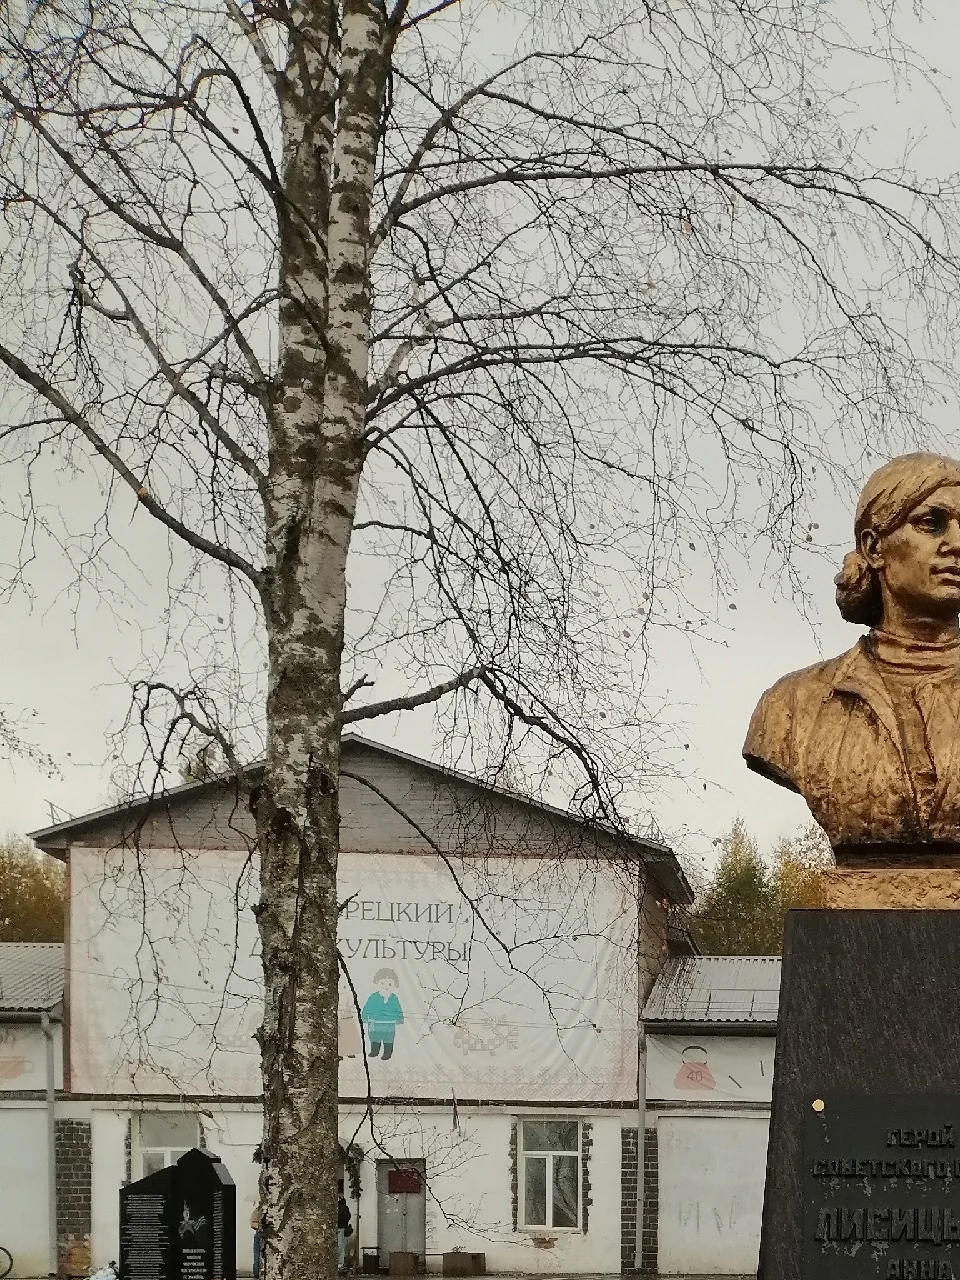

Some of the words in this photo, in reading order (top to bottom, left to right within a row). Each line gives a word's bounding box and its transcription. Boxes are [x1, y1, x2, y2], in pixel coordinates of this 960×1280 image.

[344, 900, 454, 924] РЕЦКИЙ
[886, 1123, 956, 1149] ГЕРОЙ
[812, 1158, 951, 1180] СОВЕТСКОГО
